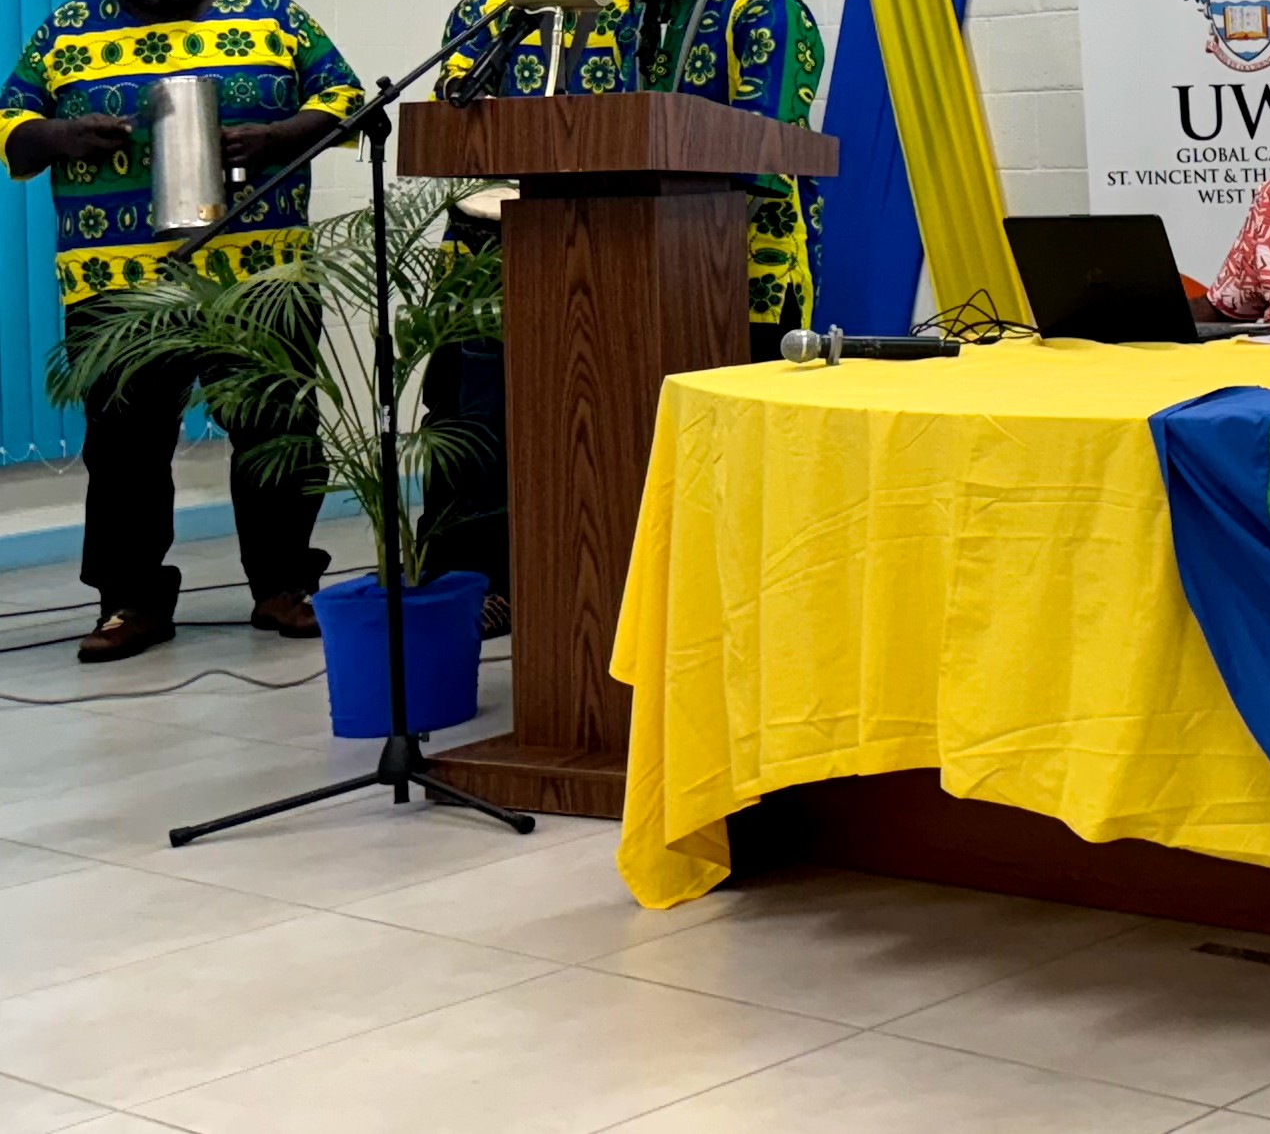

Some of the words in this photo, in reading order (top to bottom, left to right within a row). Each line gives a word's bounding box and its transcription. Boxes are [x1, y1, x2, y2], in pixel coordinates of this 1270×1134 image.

[1176, 147, 1250, 163] GLOBAL
[1107, 171, 1132, 186] ST.
[1136, 169, 1220, 184] VINCENT
[1224, 168, 1238, 183] &
[1198, 188, 1246, 204] WEST
